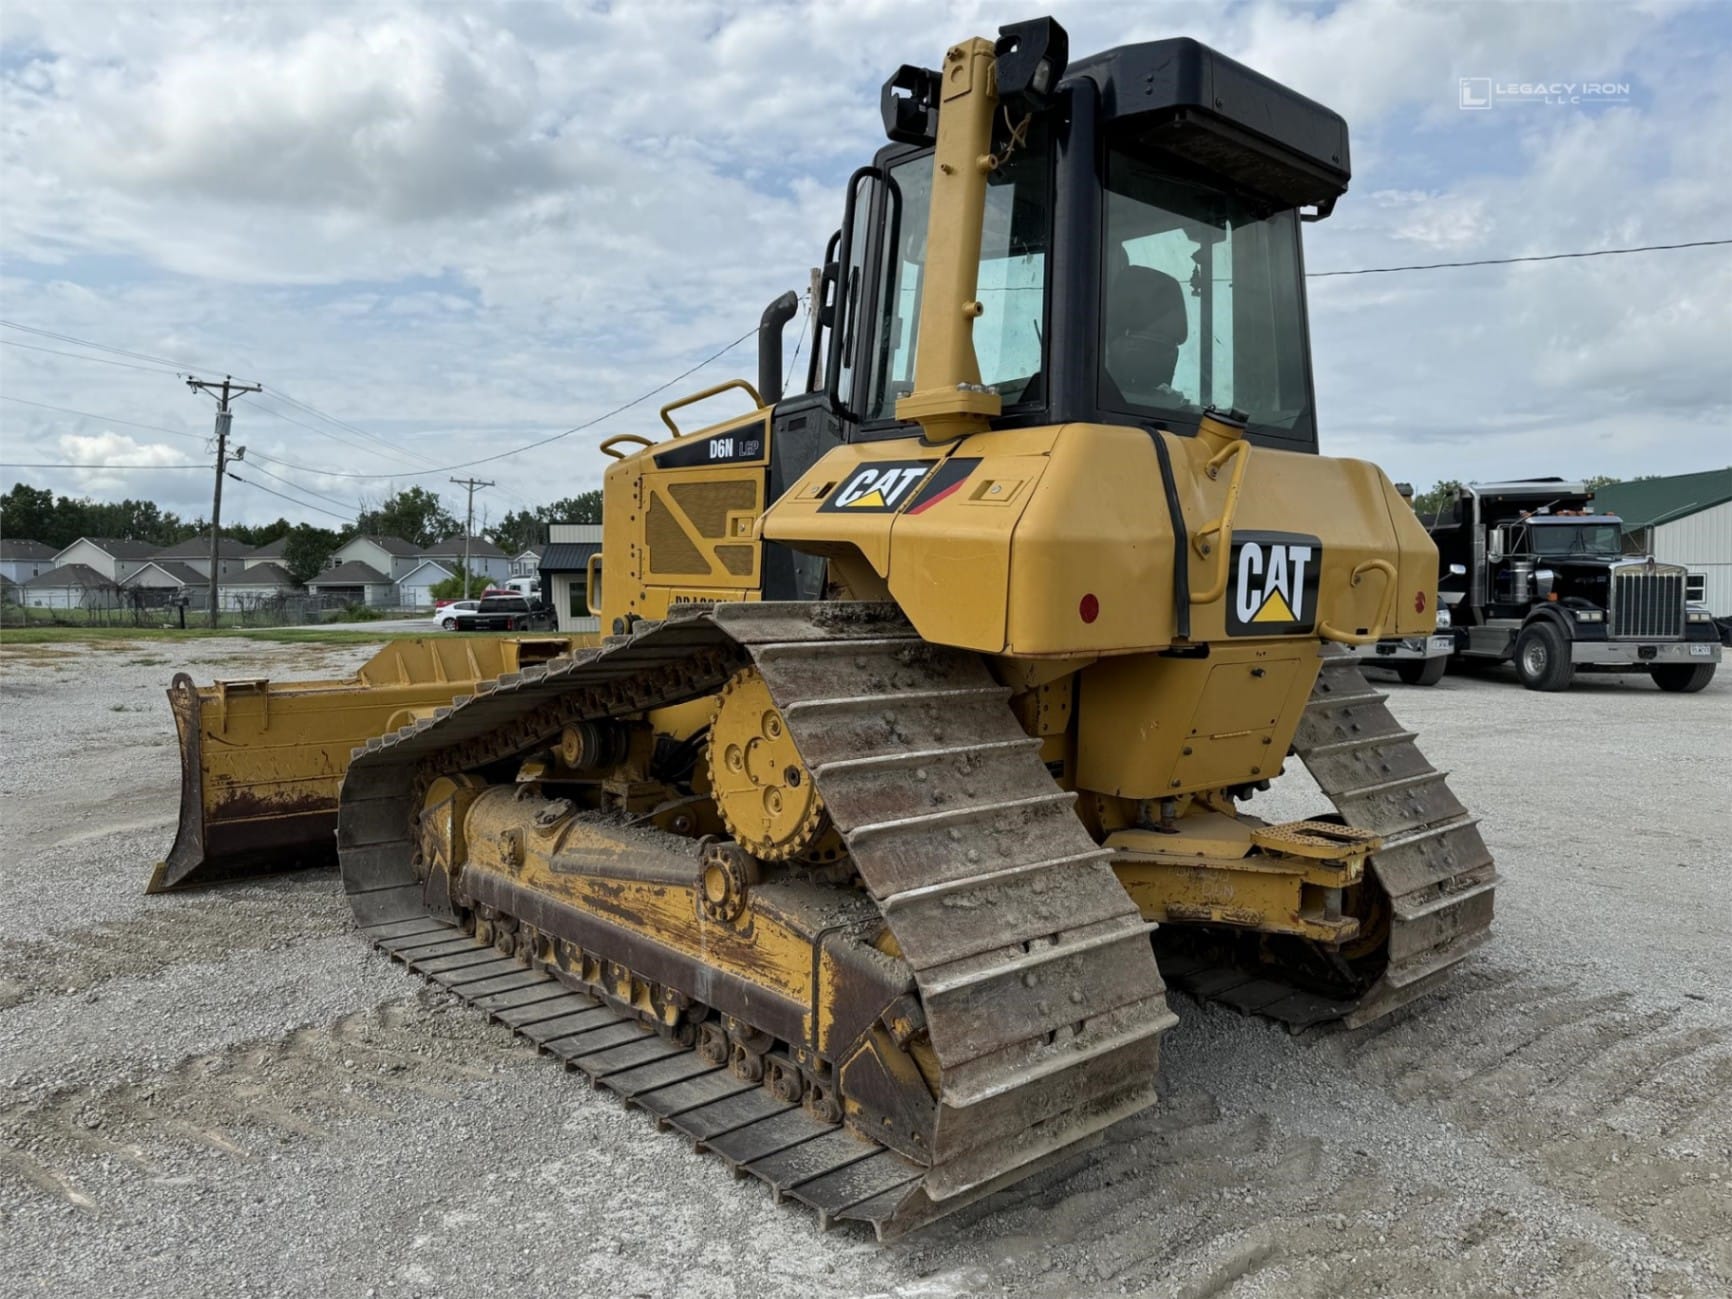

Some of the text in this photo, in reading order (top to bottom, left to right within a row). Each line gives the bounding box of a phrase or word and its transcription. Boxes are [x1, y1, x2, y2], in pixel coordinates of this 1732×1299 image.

[709, 438, 734, 459] D6N
[835, 467, 928, 507] CAT
[1236, 542, 1312, 623] CAT
